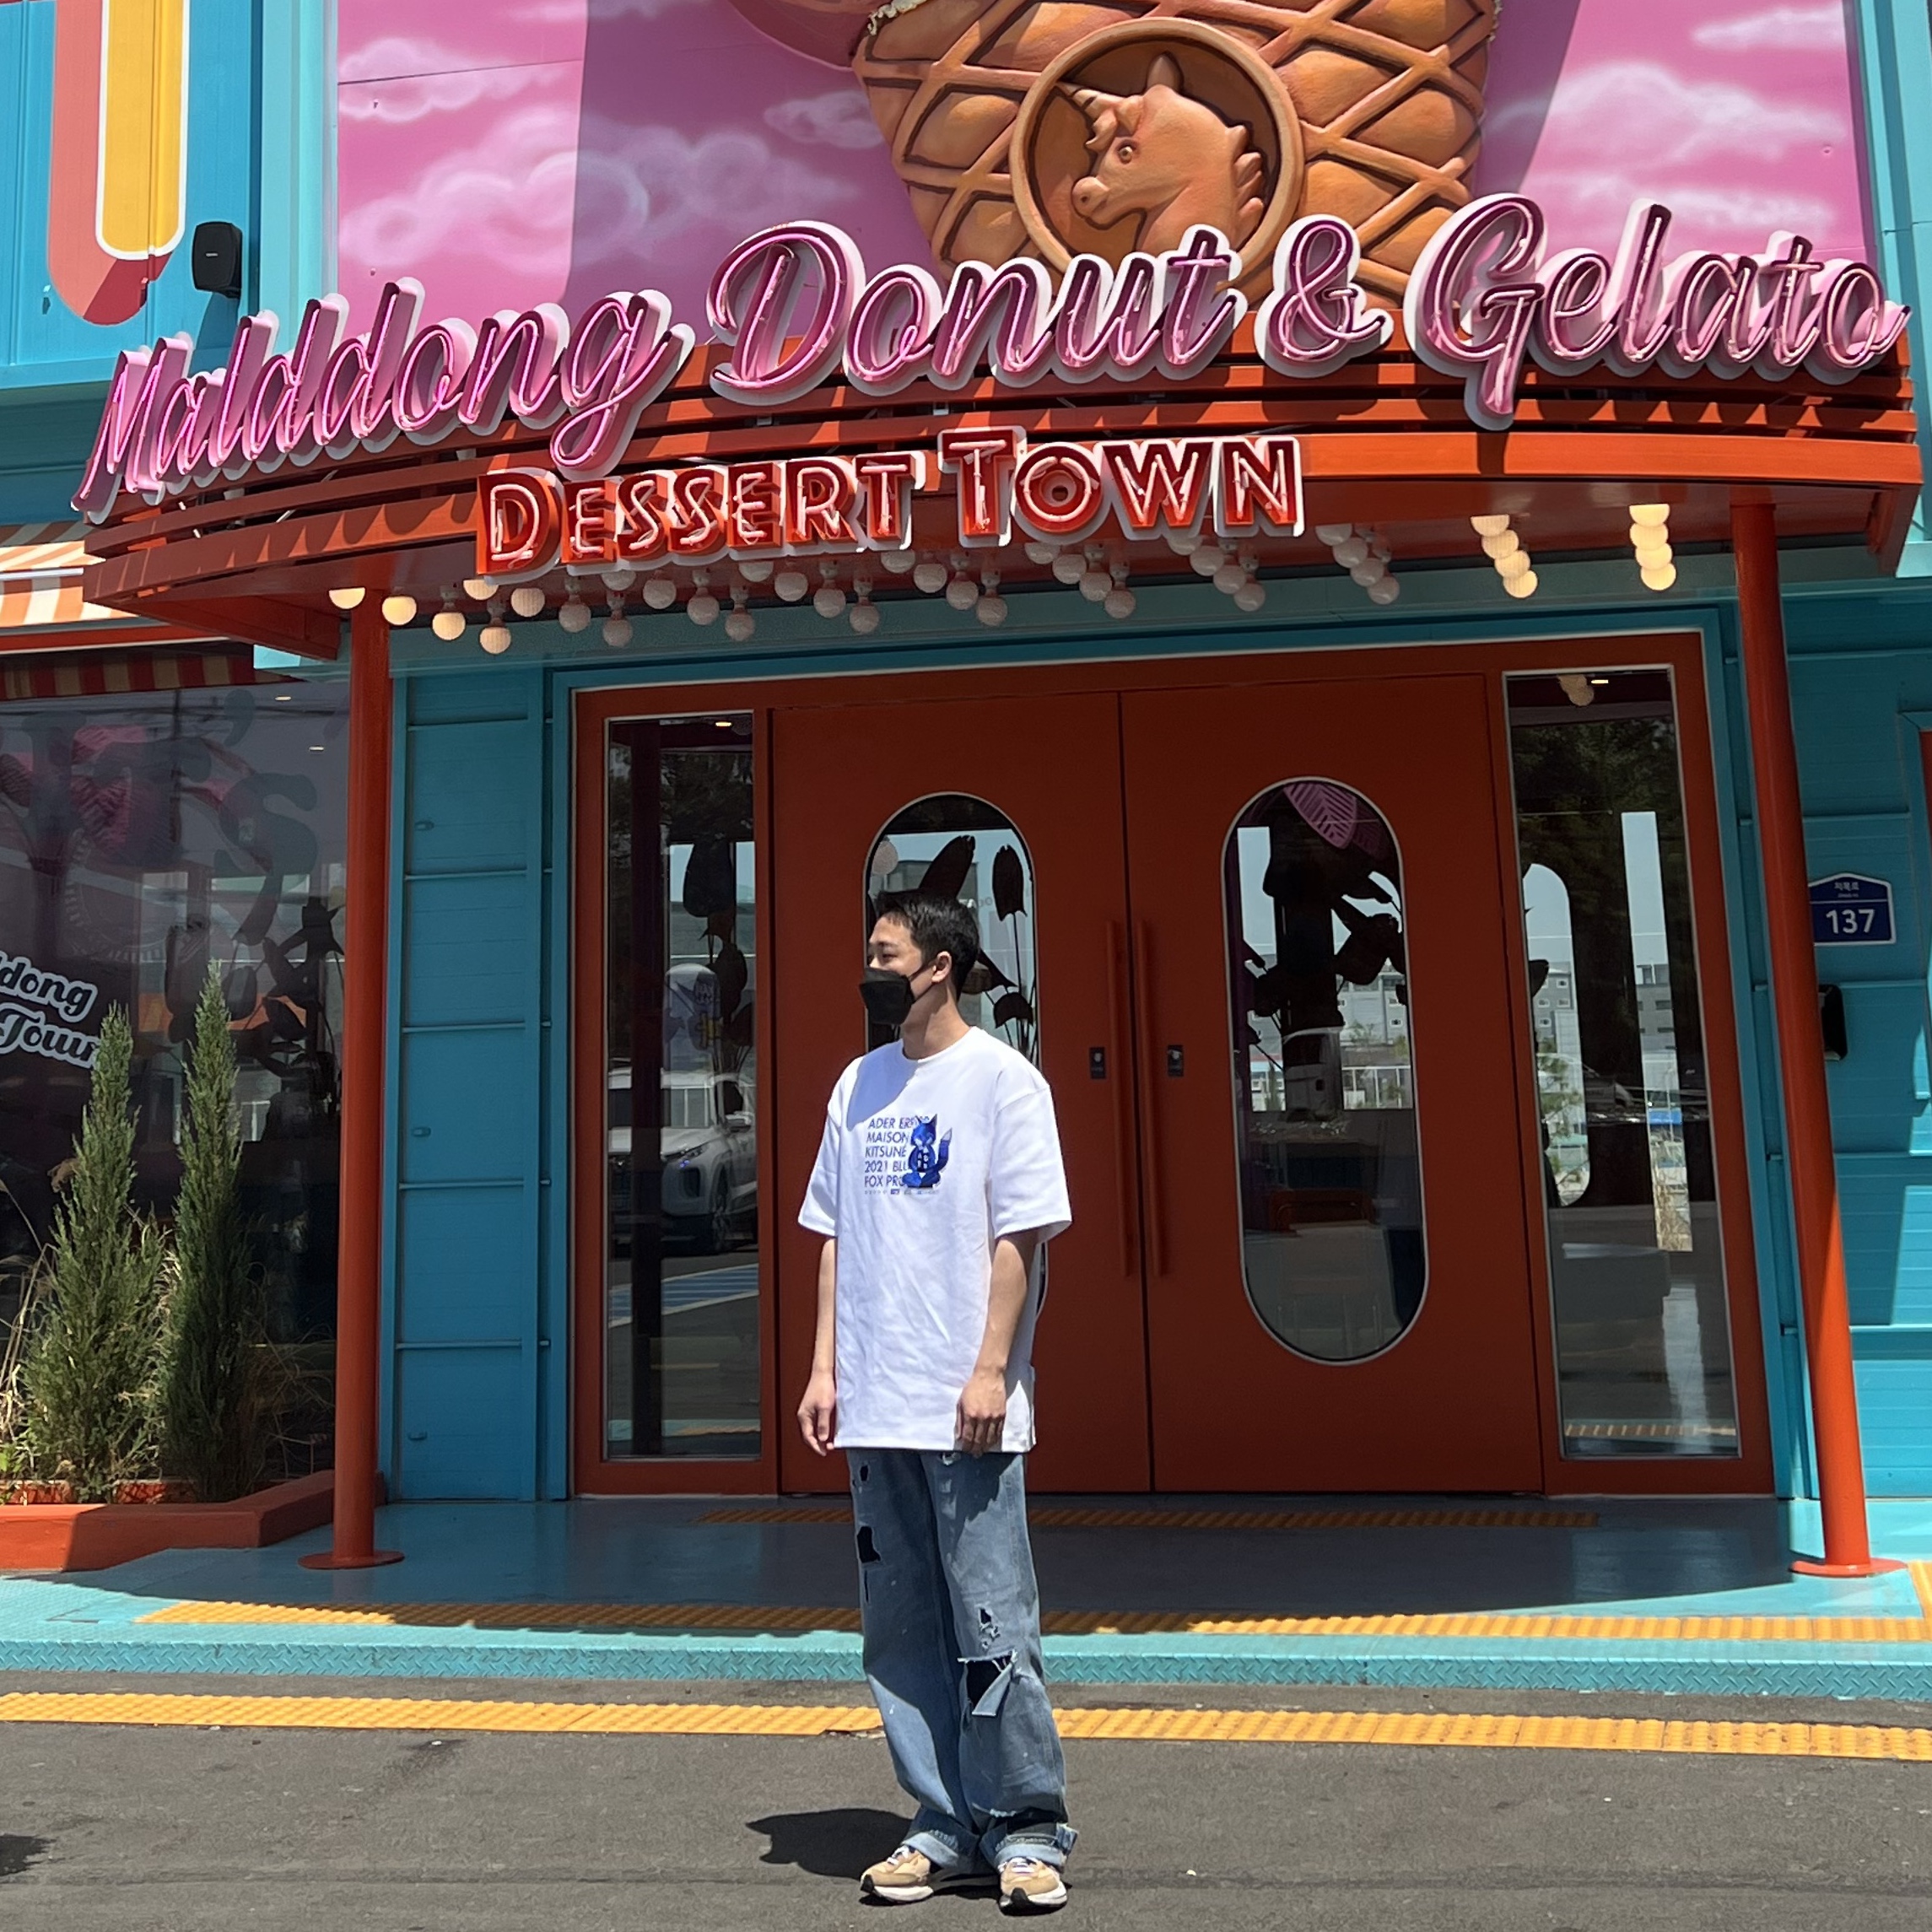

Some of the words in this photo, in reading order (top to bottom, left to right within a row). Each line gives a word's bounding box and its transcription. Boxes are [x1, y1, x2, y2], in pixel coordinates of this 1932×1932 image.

[71, 278, 694, 524] Malddong
[706, 221, 1247, 404] Donut
[1258, 214, 1395, 380] &
[1405, 192, 1913, 431] Gelato
[477, 450, 926, 583] DESSERT
[938, 425, 1303, 548] TOWN
[1825, 908, 1875, 935] 137
[0, 953, 98, 1023] dong
[867, 1116, 895, 1130] ADER
[866, 1131, 909, 1143] MAISON
[864, 1160, 888, 1174] 2021
[864, 1174, 883, 1188] FOX
